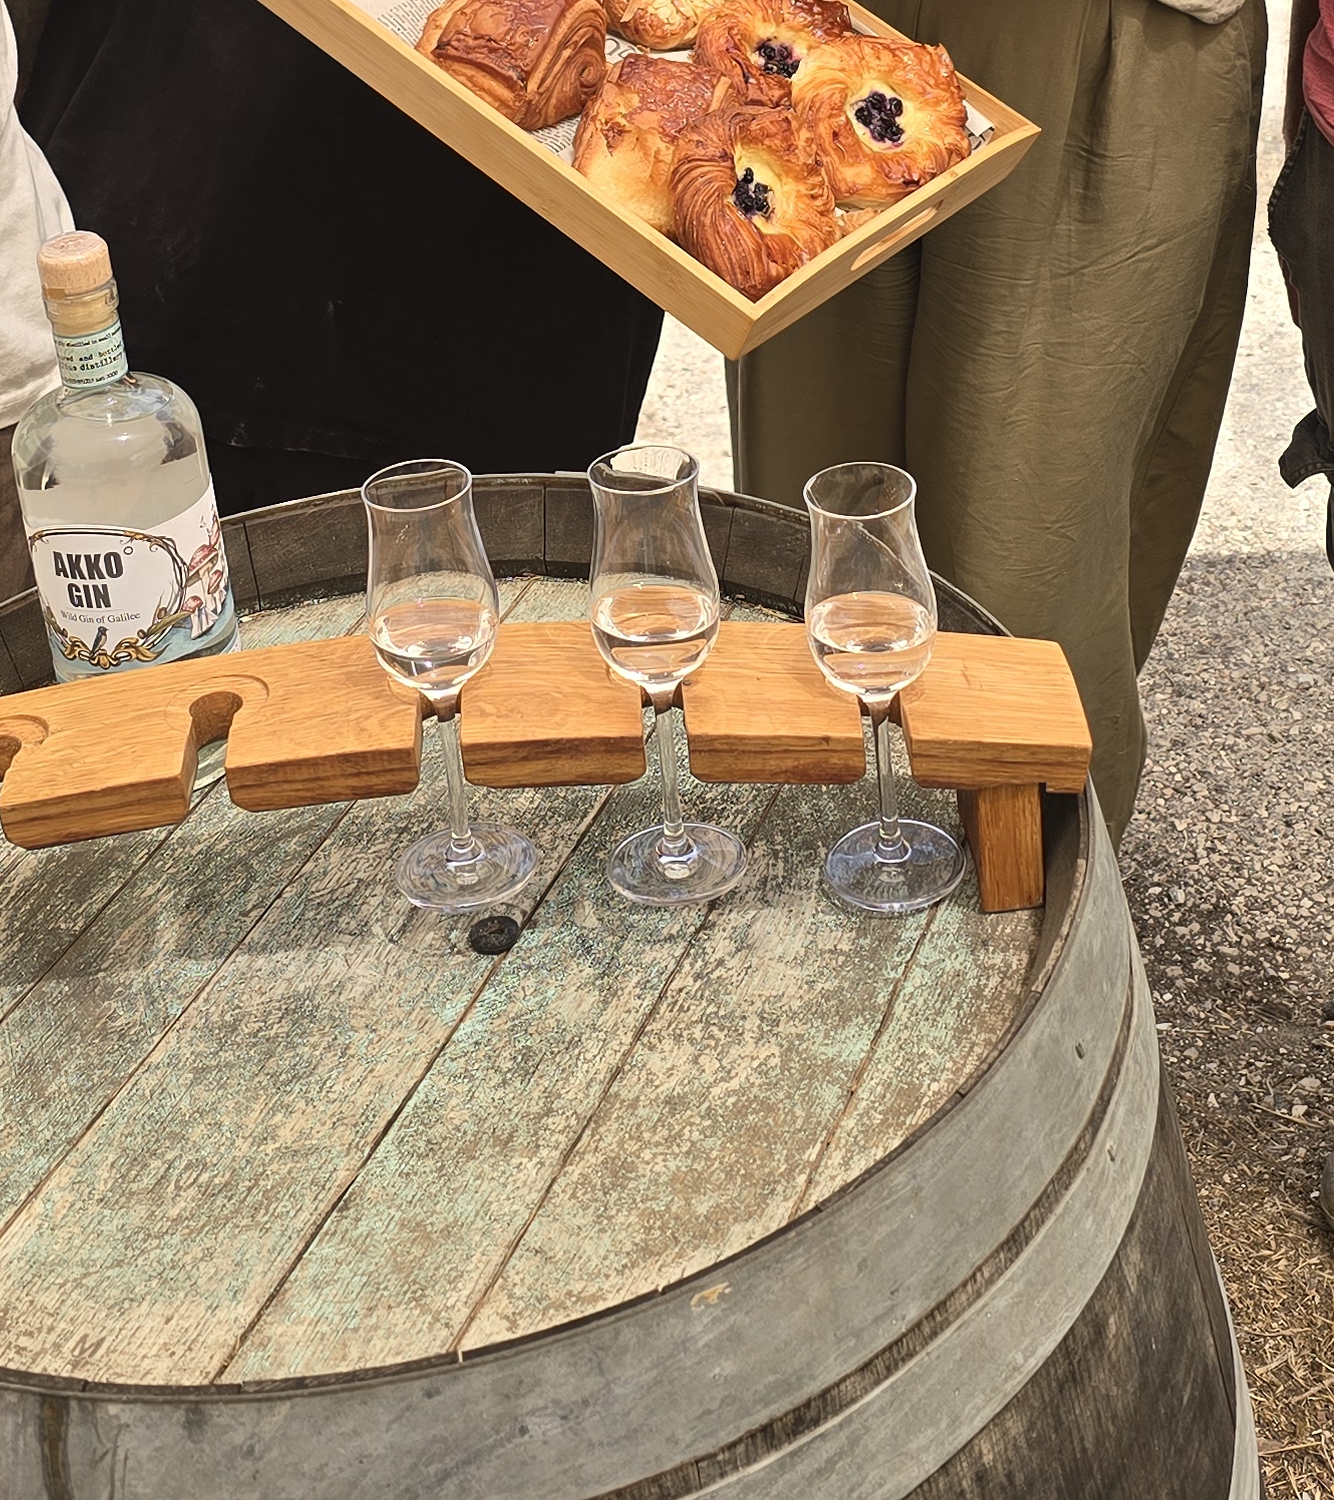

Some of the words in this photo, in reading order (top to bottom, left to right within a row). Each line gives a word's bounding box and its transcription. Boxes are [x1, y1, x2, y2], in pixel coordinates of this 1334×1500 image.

[79, 353, 94, 362] and
[52, 550, 124, 581] AKKO
[67, 582, 112, 609] GIN
[61, 610, 78, 622] Wild
[78, 614, 95, 624] Gin
[96, 615, 106, 624] of
[107, 612, 141, 623] Galilee
